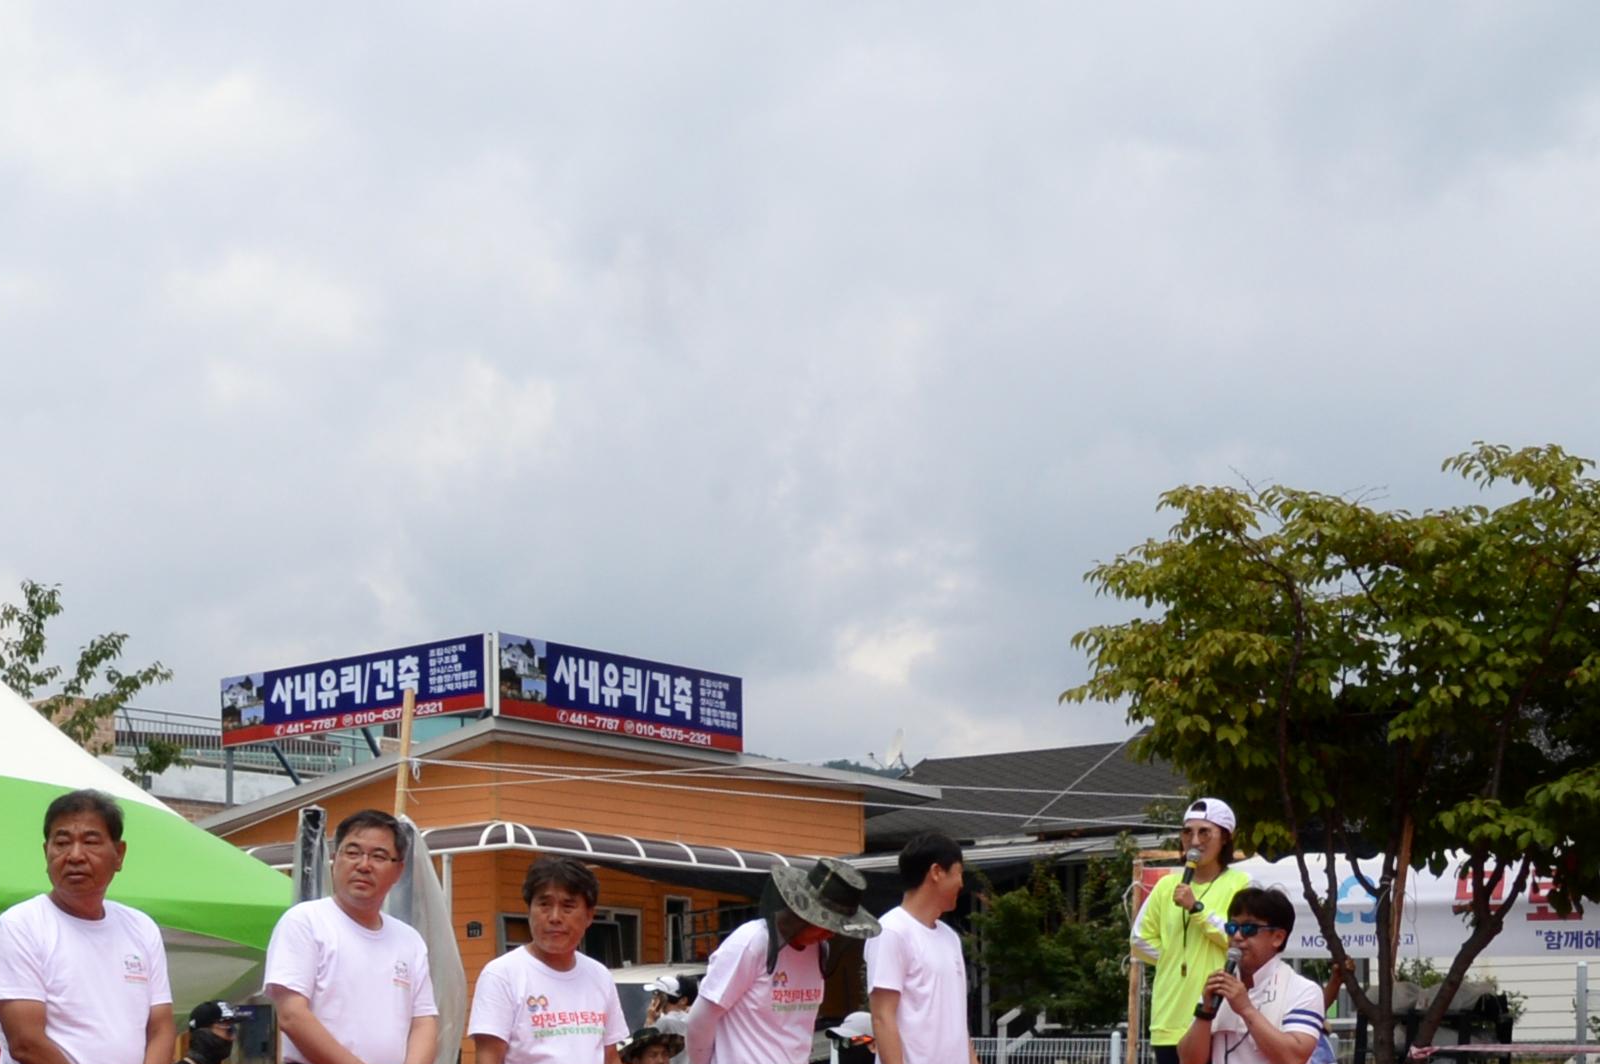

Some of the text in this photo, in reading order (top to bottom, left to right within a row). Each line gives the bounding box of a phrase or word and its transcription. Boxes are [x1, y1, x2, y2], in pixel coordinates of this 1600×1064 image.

[271, 656, 420, 715] 사내유리/건축
[554, 655, 693, 720] 사내유리/건축
[286, 702, 443, 735] 441-7787 010-637-2321
[569, 712, 712, 746] 441-7787 010-6375-2321
